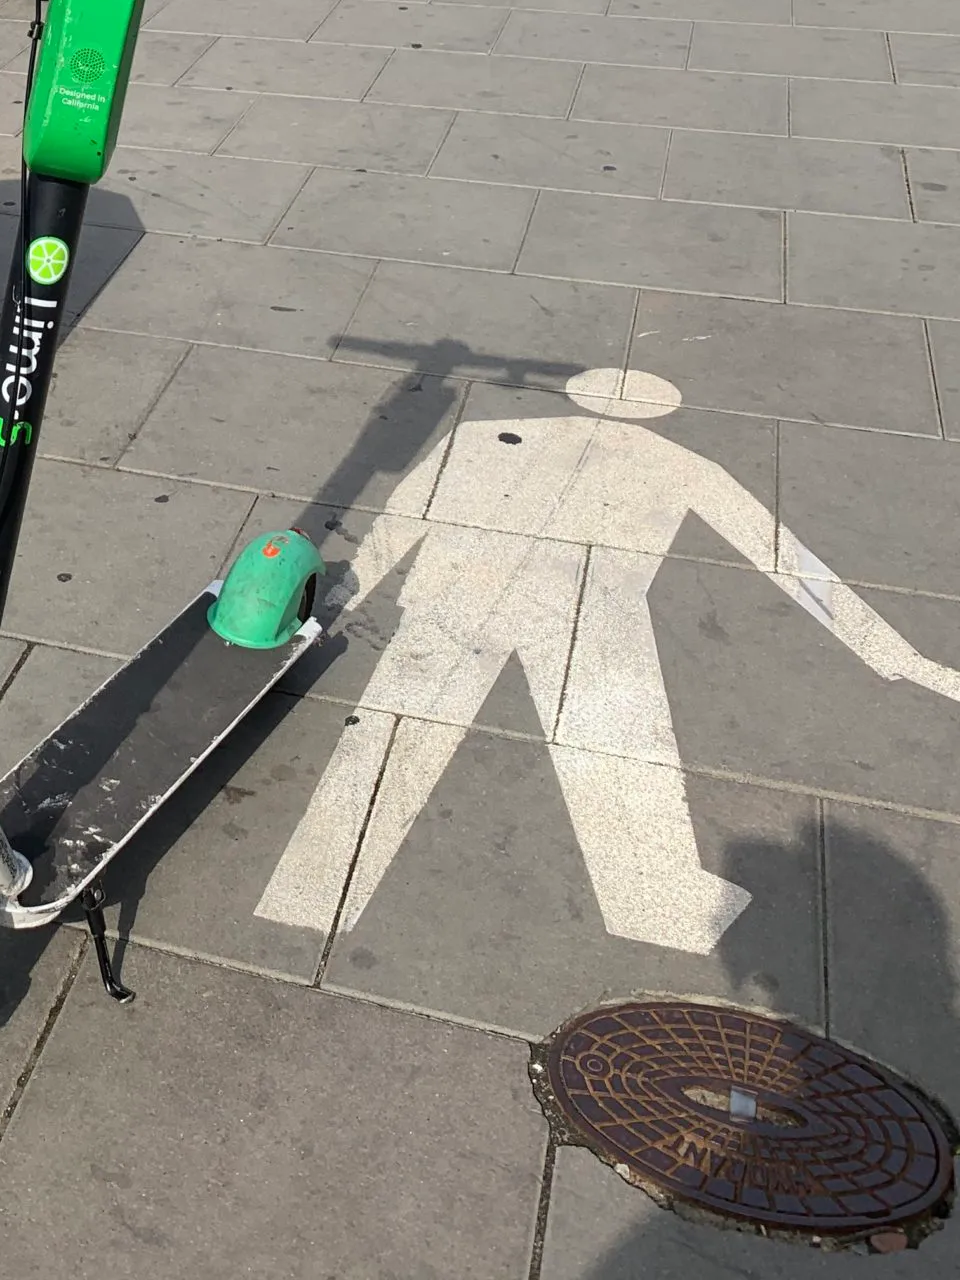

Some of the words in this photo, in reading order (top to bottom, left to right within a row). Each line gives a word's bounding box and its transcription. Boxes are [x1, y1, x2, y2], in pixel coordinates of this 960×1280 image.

[59, 87, 96, 100] Designed
[98, 94, 106, 103] in
[62, 98, 100, 111] California
